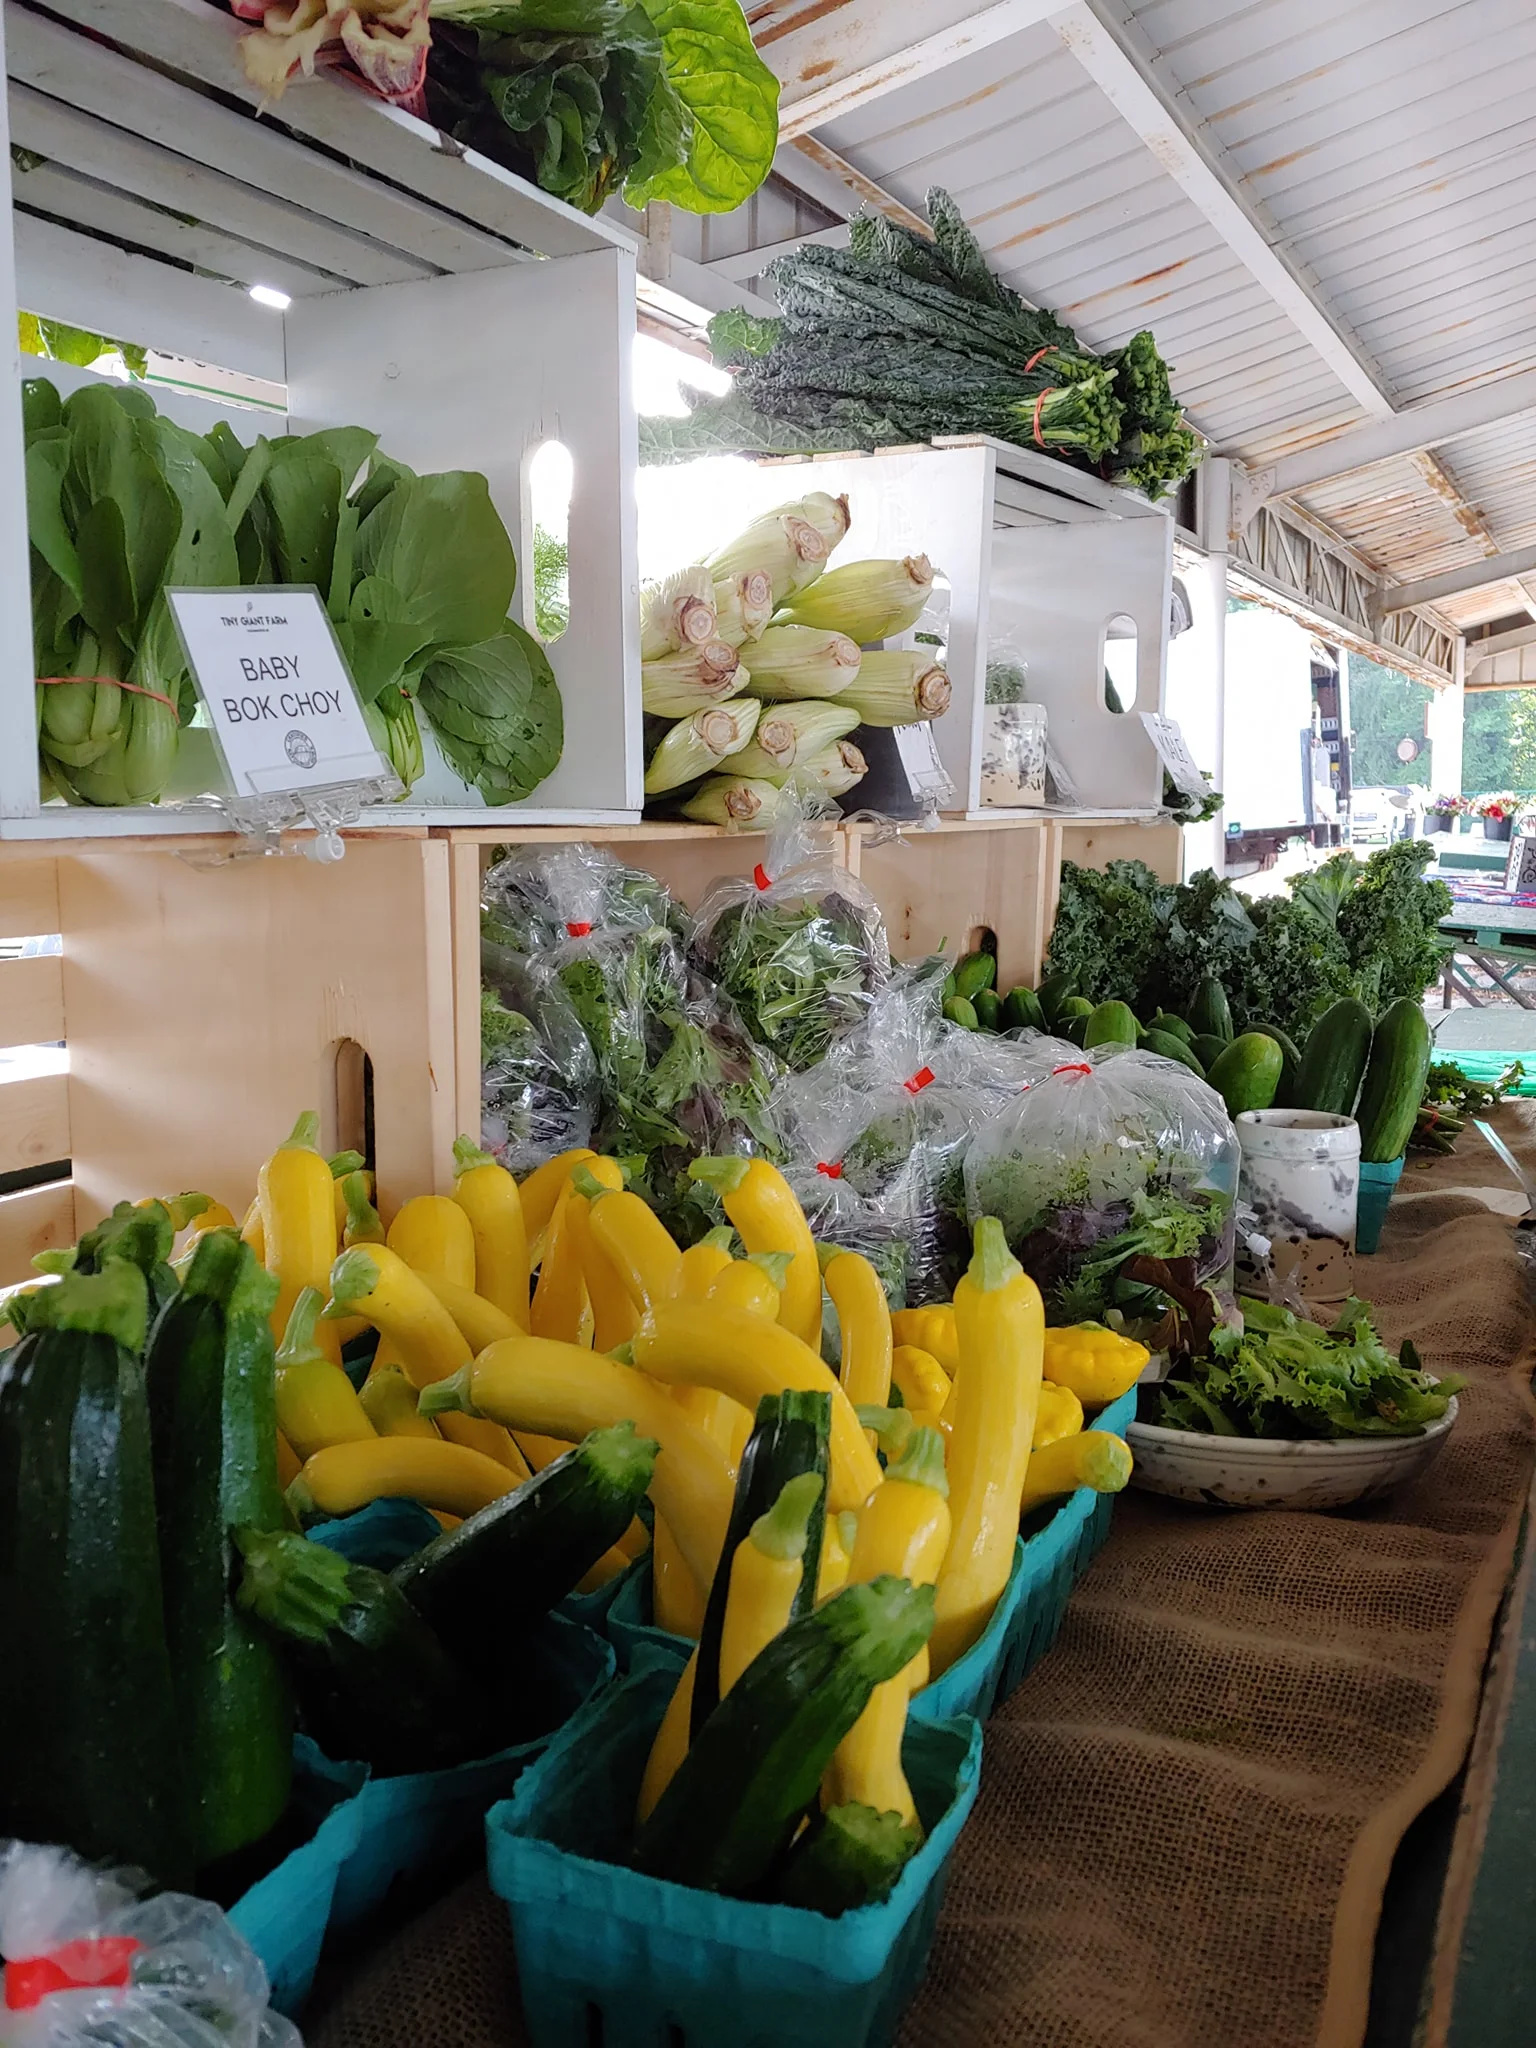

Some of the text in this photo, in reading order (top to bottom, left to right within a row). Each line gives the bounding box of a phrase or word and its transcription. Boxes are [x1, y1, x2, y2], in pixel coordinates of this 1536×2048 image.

[220, 616, 289, 626] TINY GIANT FARM
[240, 655, 301, 681] BABY
[223, 690, 342, 723] BOK CHOY
